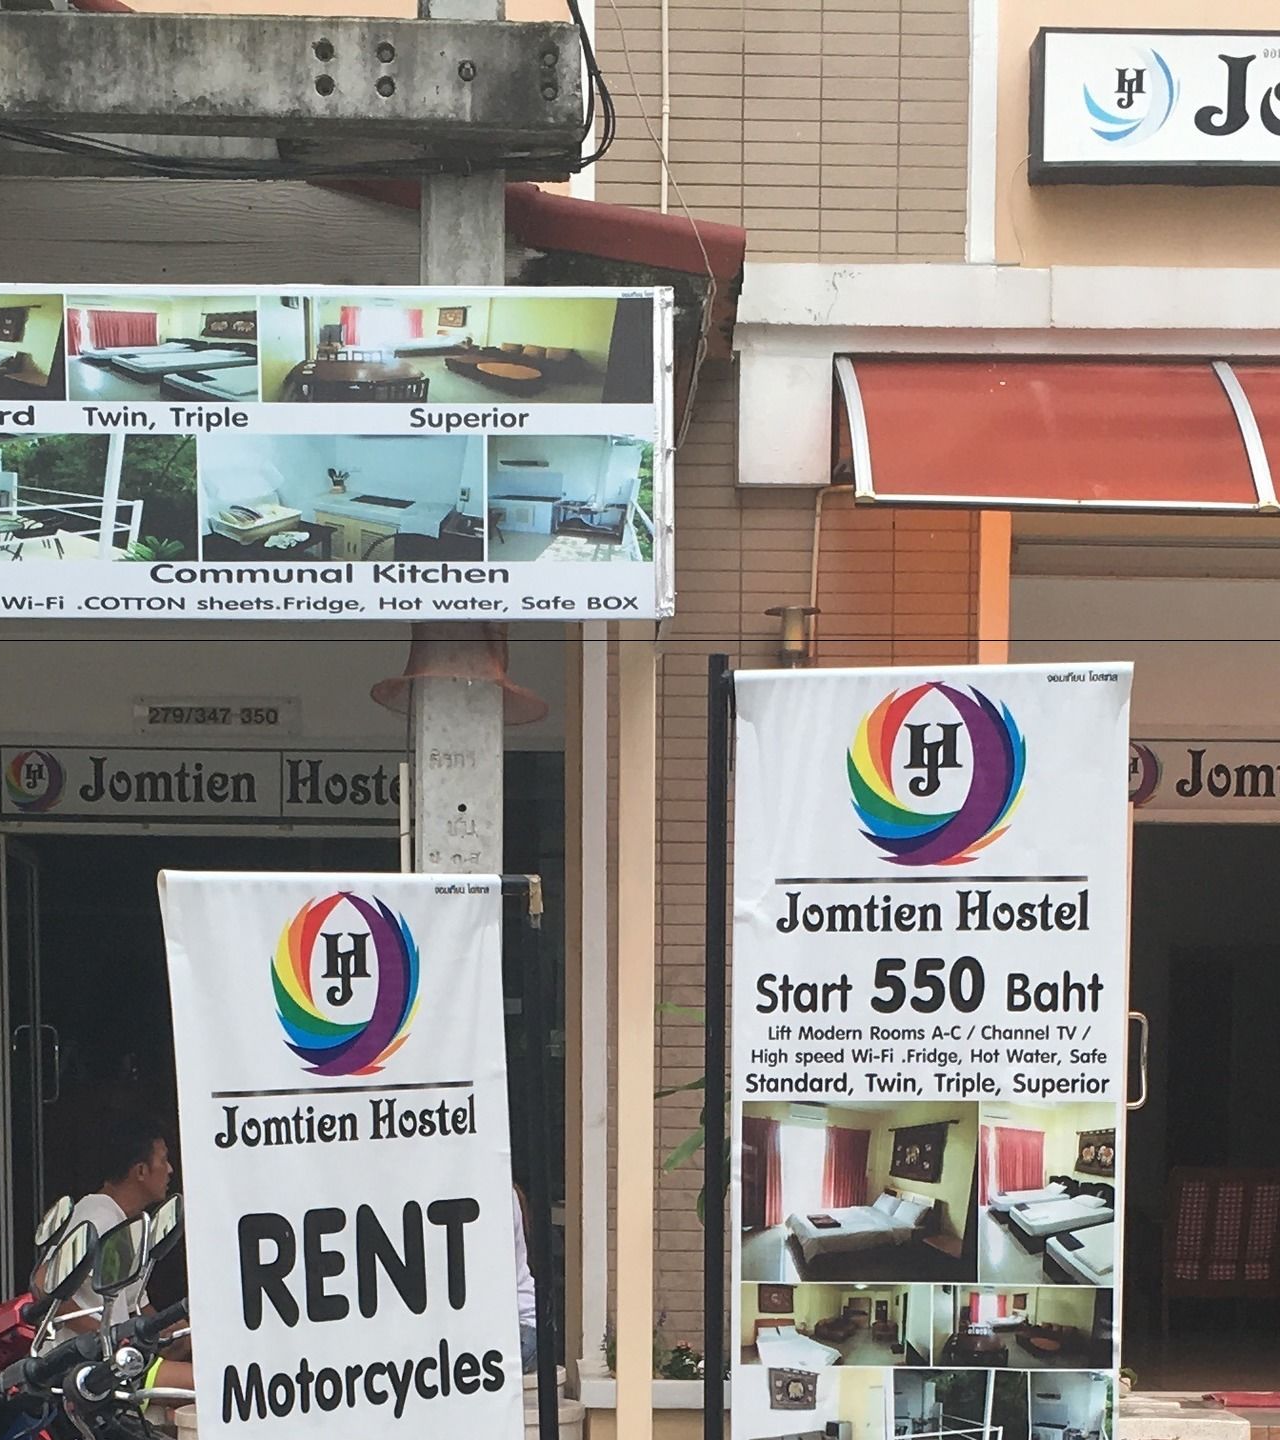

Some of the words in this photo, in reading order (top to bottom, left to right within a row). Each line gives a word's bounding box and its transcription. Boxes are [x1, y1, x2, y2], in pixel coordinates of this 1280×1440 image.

[82, 405, 156, 431] Twin,
[169, 406, 249, 433] Triple
[410, 407, 530, 433] Superior
[149, 562, 353, 584] Communal
[373, 562, 509, 584] Kitchen
[1, 595, 64, 610] Wi-Fi
[379, 596, 423, 611] Hot
[432, 597, 509, 613] water,
[521, 595, 576, 610] Safe
[587, 596, 639, 610] BOX
[79, 756, 257, 803] Jomtien
[775, 891, 943, 934] Jomtien
[955, 888, 1090, 932] Hostel
[755, 973, 853, 1014] Start
[870, 955, 986, 1014] 550
[1006, 969, 1105, 1013] Baht
[768, 1024, 793, 1041] Lift
[798, 1024, 863, 1041] Modern
[870, 1025, 926, 1041] Rooms
[931, 1025, 962, 1041] A-C
[981, 1024, 1050, 1041] Channel
[1056, 1025, 1078, 1041] TV
[751, 1048, 788, 1068] High
[795, 1048, 845, 1067] speed
[851, 1047, 894, 1064] Wi-Fi
[970, 1048, 1001, 1064] Hot
[1006, 1048, 1062, 1066] Water,
[1069, 1047, 1108, 1064] Safe
[745, 1071, 854, 1097] Standard,
[864, 1071, 923, 1096] Twin,
[933, 1071, 1001, 1098] Triple,
[1012, 1072, 1111, 1099] Superior
[214, 1105, 360, 1149] Jomtien
[368, 1093, 477, 1140] Hostel
[237, 1197, 481, 1331] RENT
[221, 1337, 506, 1424] Motorcycles
